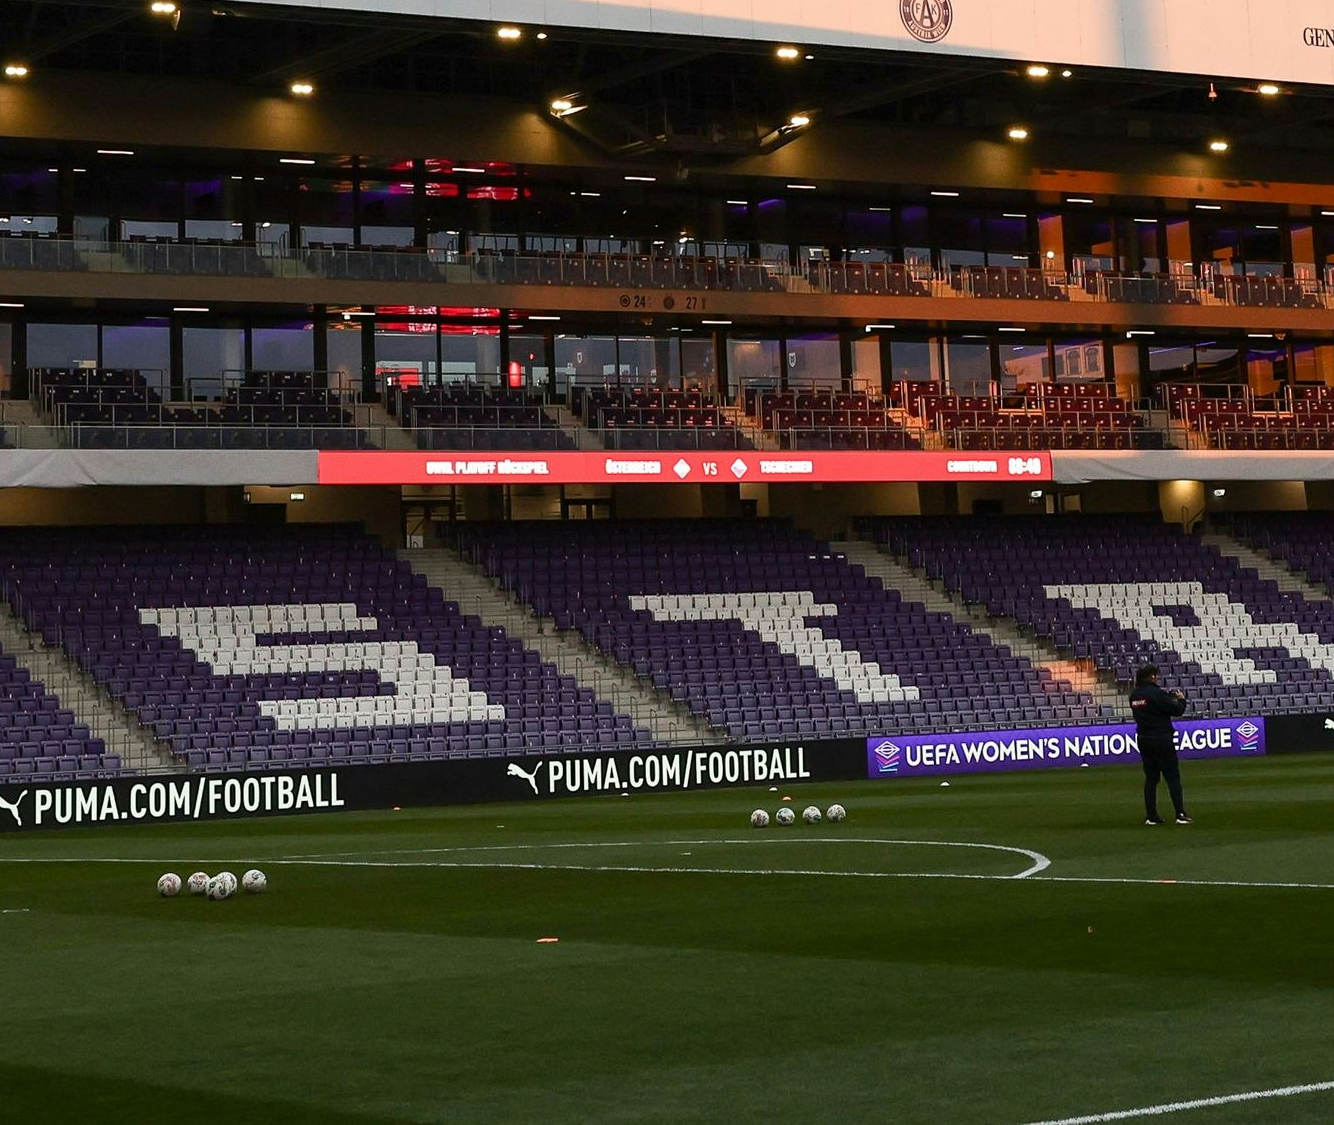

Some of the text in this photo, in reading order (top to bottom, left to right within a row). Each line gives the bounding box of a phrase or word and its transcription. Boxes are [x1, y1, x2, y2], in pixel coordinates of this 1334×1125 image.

[634, 295, 646, 308] 24
[686, 297, 697, 310] 27
[702, 462, 718, 476] VS
[906, 727, 1232, 767] UEFA WOMEN'S NATION EAGUE
[548, 747, 811, 793] PUMA.COM/FOOTBALL
[35, 773, 345, 825] PUMA.COM/FOOTBALL
